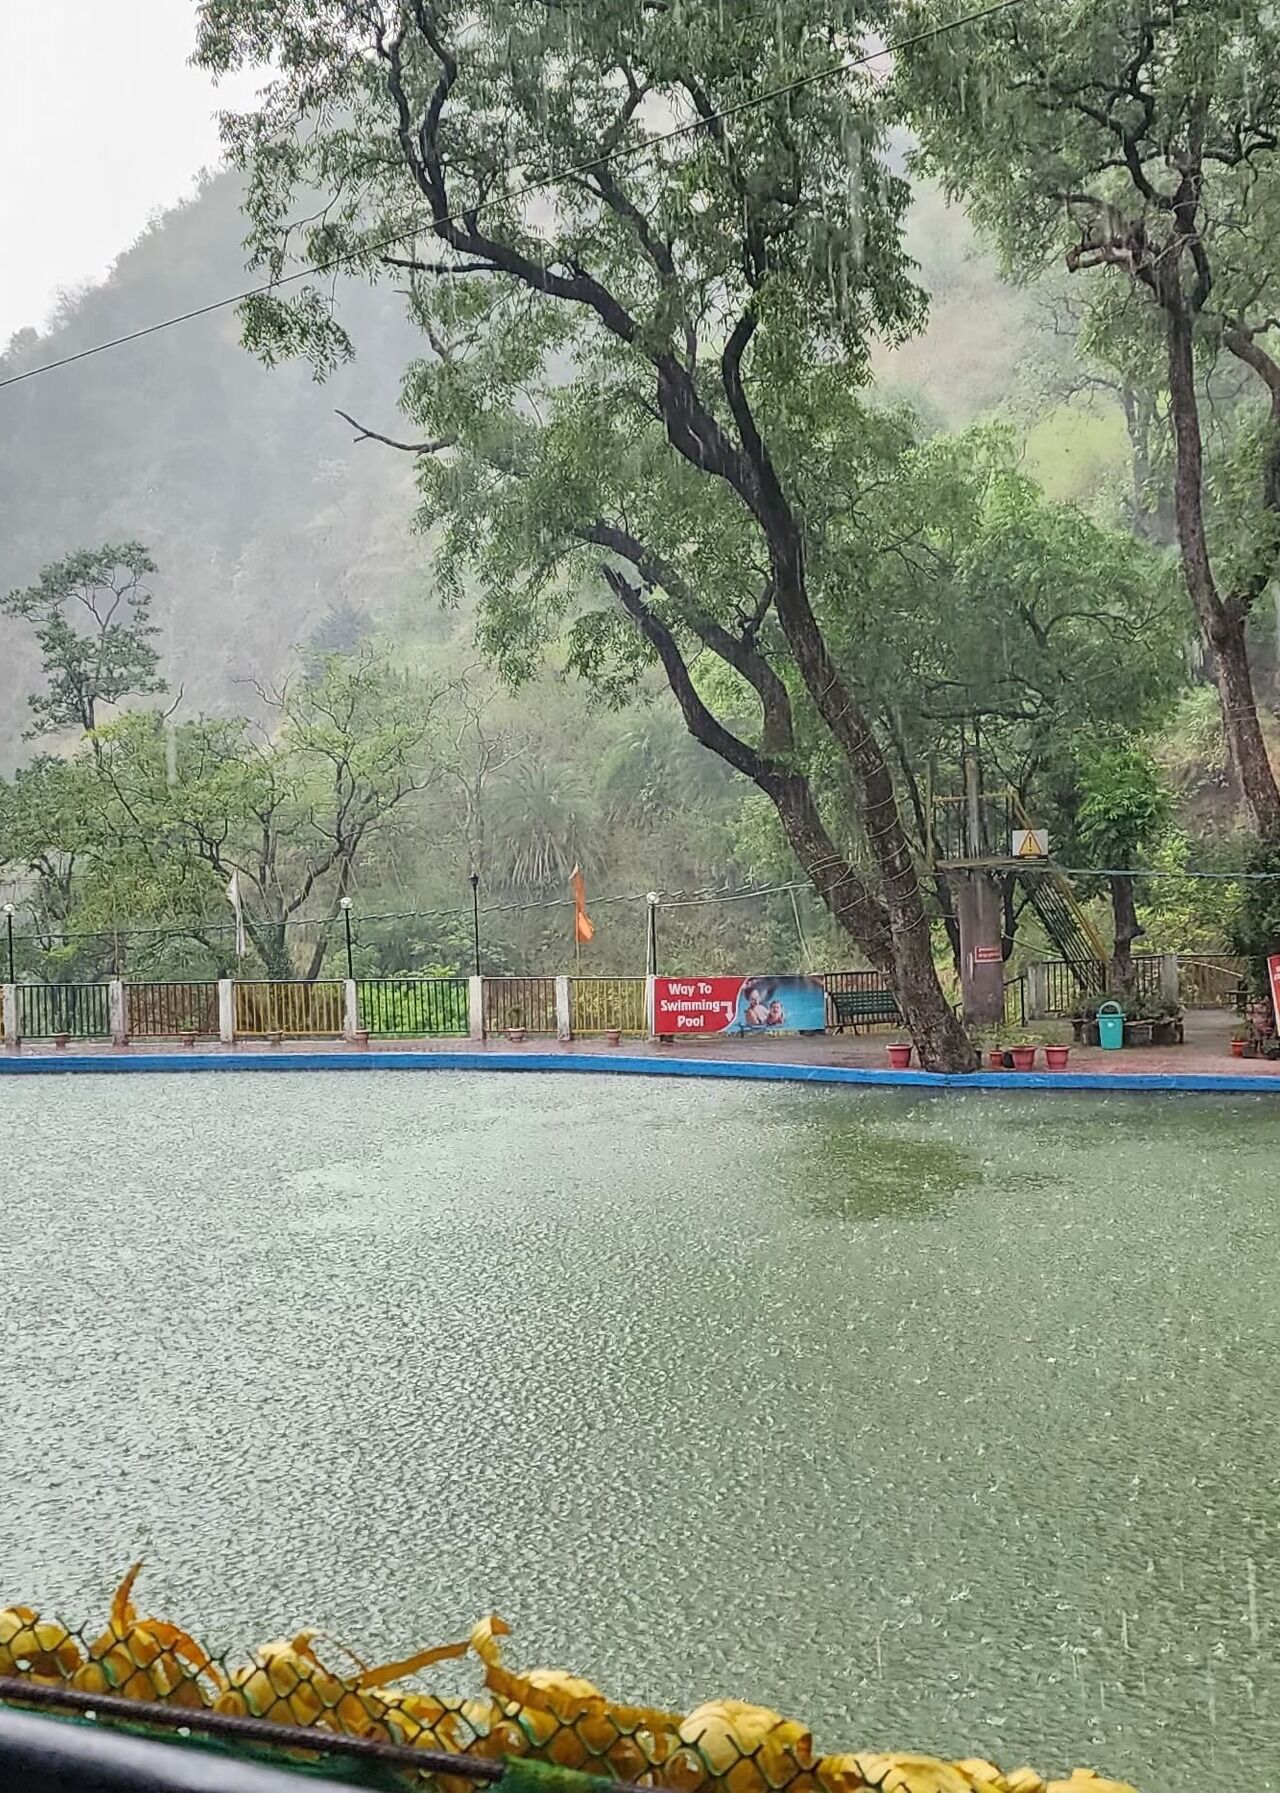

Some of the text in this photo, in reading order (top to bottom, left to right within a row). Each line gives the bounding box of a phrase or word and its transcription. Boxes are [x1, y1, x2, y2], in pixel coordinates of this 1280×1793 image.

[668, 982, 712, 997] Way To
[660, 999, 720, 1013] Swimming
[677, 1015, 704, 1027] Pool
